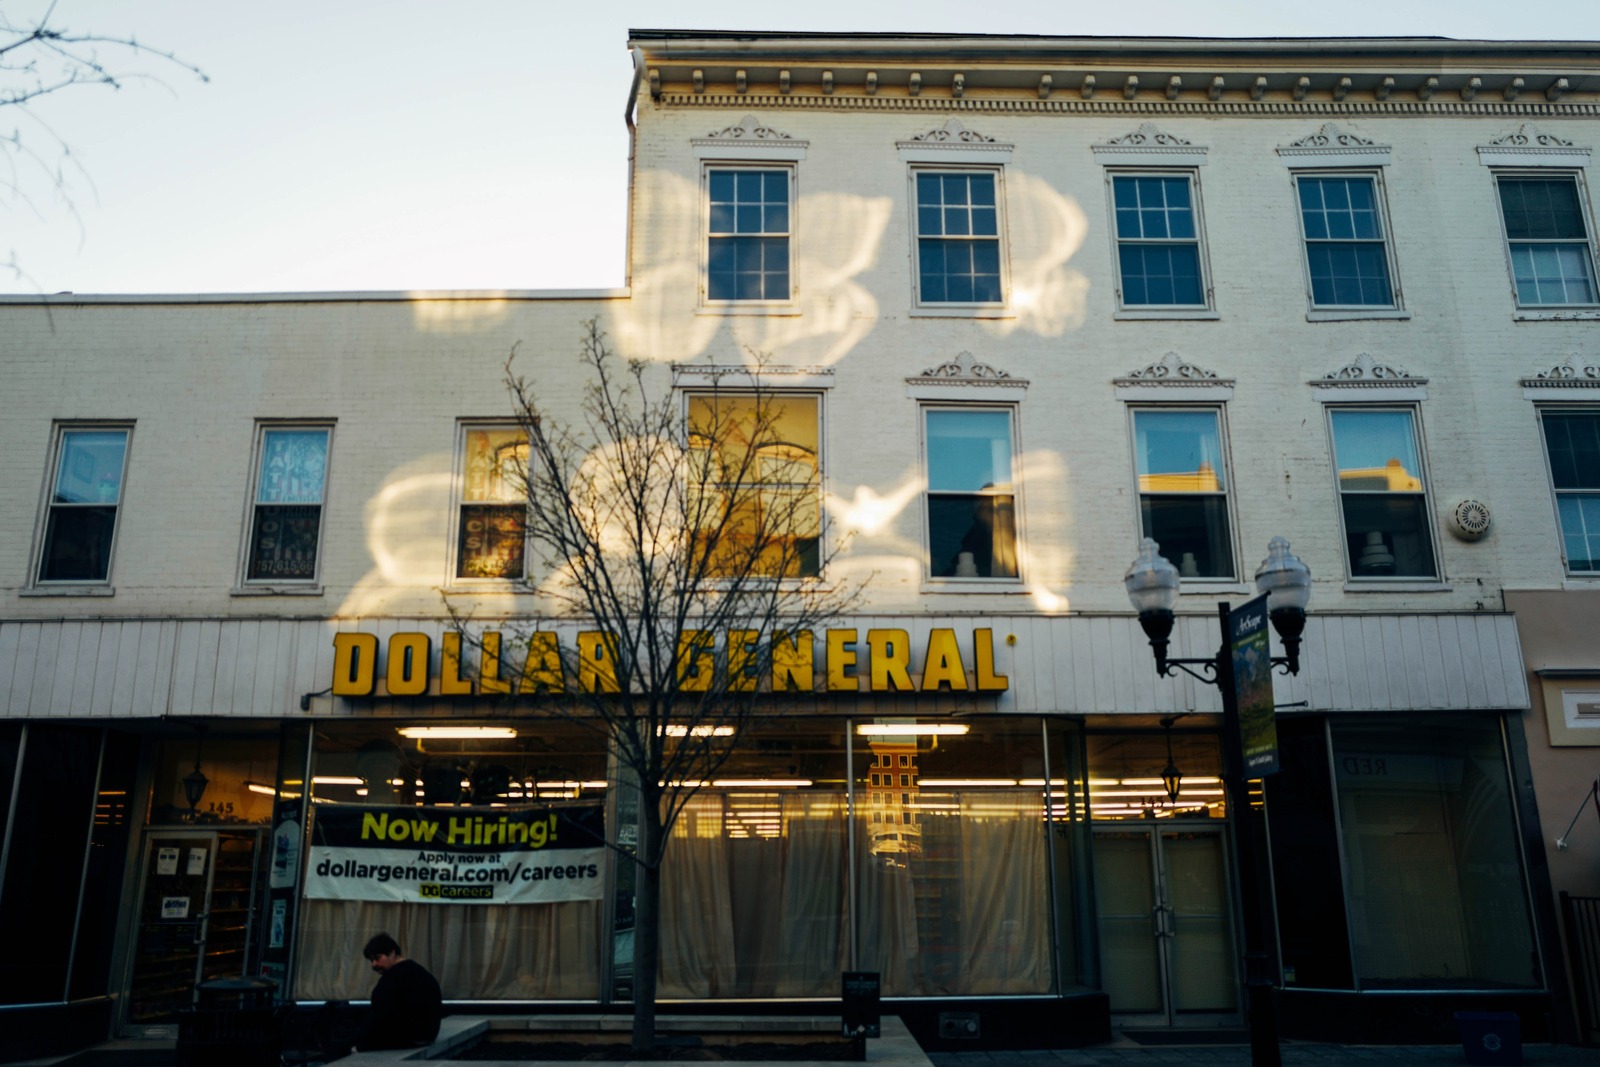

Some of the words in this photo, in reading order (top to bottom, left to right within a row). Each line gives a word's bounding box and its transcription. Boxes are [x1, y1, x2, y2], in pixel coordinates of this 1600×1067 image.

[332, 631, 621, 696] DOLLAR
[675, 628, 1009, 691] GENERAL
[209, 802, 234, 813] 145
[361, 812, 439, 842] Now
[447, 813, 558, 848] Hiring!
[418, 851, 455, 864] Apply
[458, 855, 485, 863] now
[488, 853, 501, 863] at
[316, 859, 598, 884] dollargeneral.com/careers
[441, 885, 492, 897] careers
